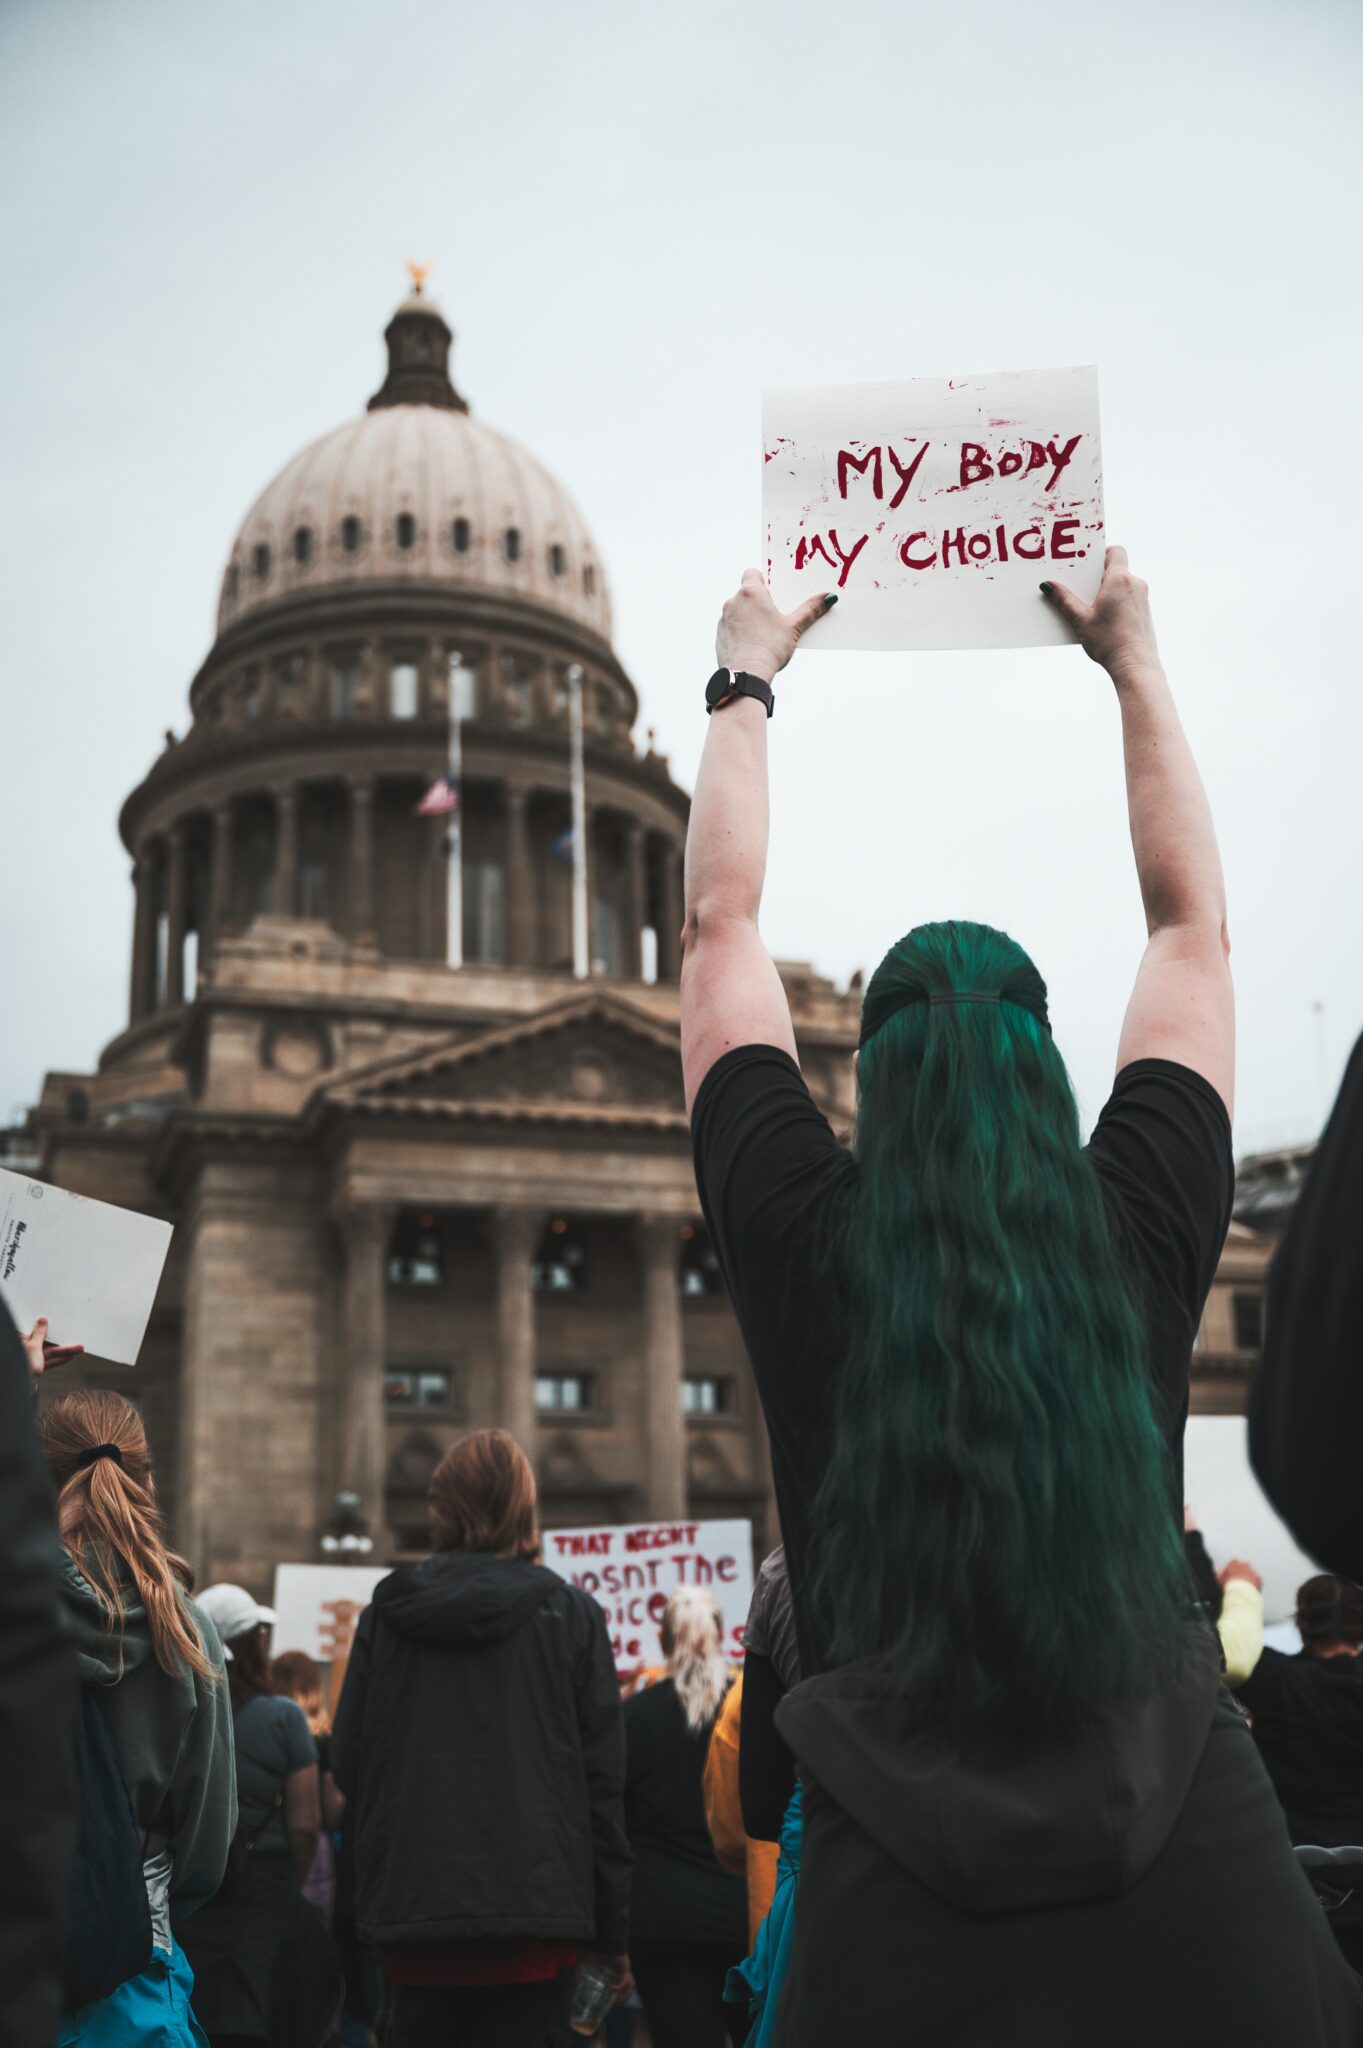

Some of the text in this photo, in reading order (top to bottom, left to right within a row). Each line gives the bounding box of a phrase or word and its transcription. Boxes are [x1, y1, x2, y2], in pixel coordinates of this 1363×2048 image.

[837, 434, 1083, 509] MY BODY
[794, 519, 1086, 587] MY CHOICE.
[553, 1524, 698, 1556] THAT NIGHT
